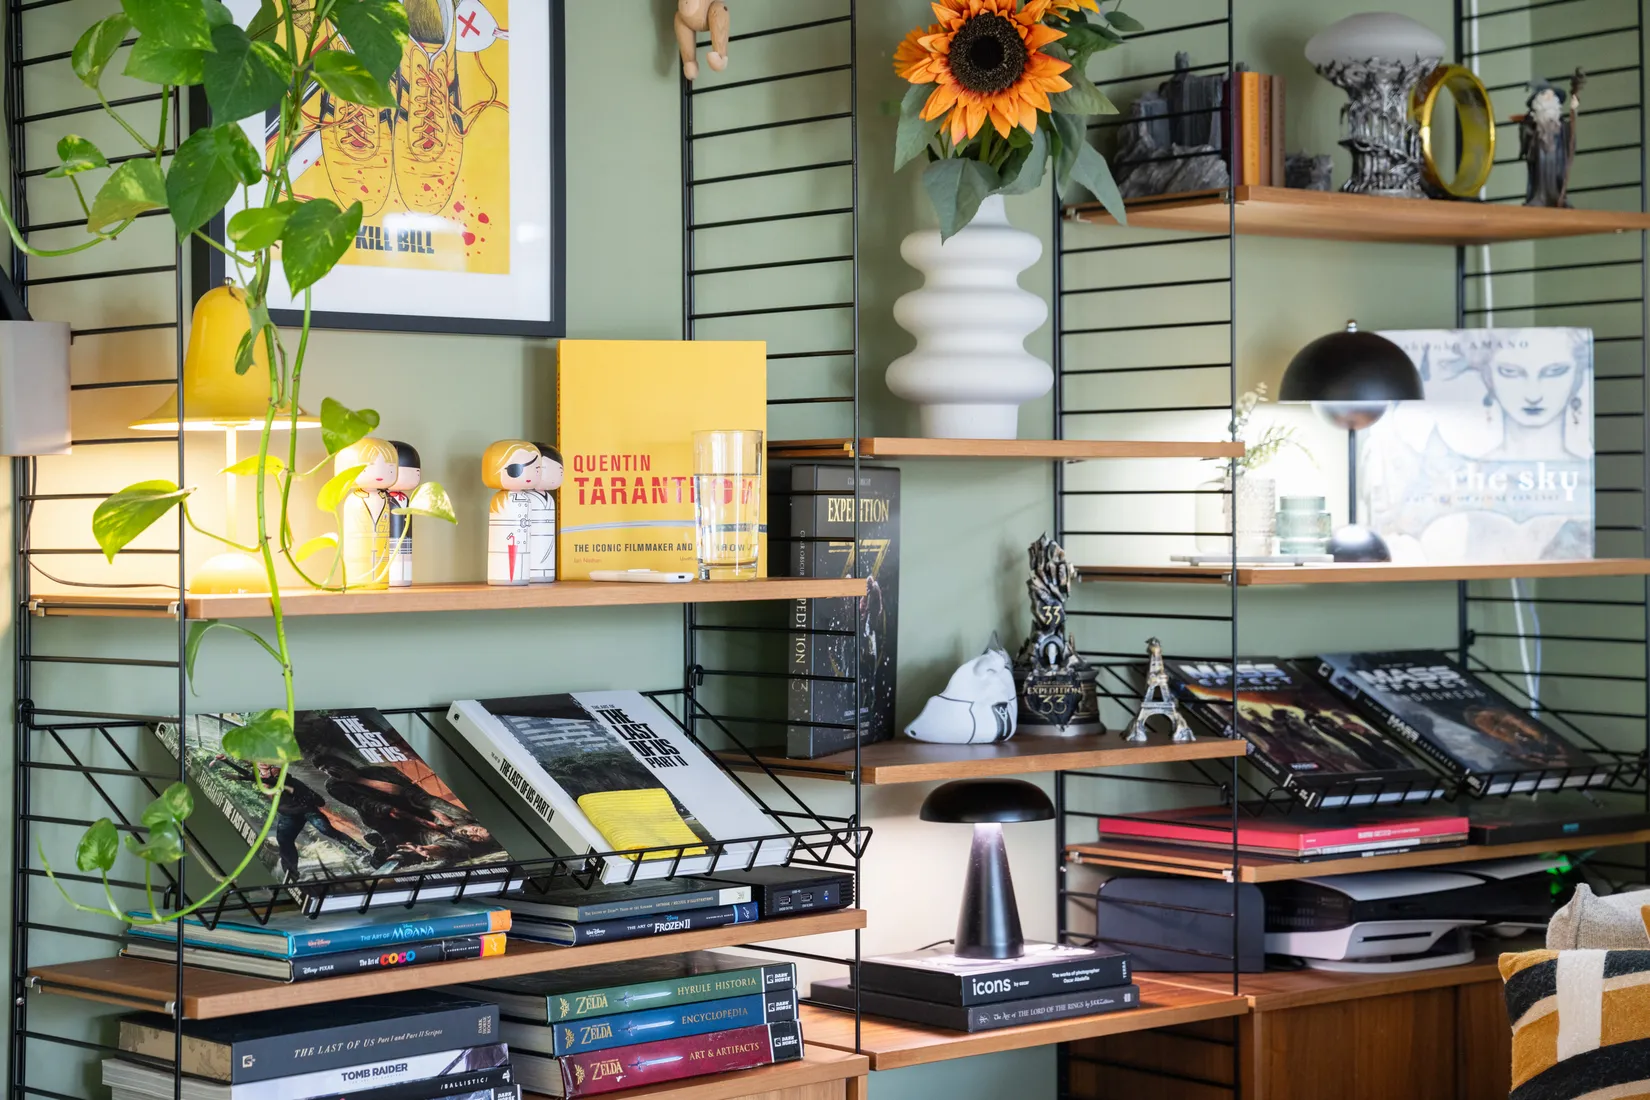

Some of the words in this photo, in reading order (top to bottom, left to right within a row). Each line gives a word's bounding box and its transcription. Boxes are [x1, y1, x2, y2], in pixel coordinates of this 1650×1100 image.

[355, 225, 392, 251] KILL
[397, 228, 434, 254] BILL
[1469, 340, 1529, 350] AMANO
[573, 455, 651, 473] QUENTIN
[1518, 461, 1578, 501] sky
[827, 498, 890, 522] EXPEITION
[574, 544, 589, 552] THE
[592, 544, 620, 552] ICONIC
[625, 543, 674, 551] FILMMAKER
[677, 542, 693, 551] AND
[1042, 606, 1062, 625] 33
[1356, 665, 1461, 684] MASS
[1027, 687, 1082, 695] EXPEDITION
[1374, 679, 1468, 692] EFFECT
[1038, 695, 1067, 714] 33
[596, 708, 636, 724] THE
[332, 718, 370, 734] THE
[611, 723, 660, 740] LAST
[344, 732, 390, 748] LAST
[628, 740, 656, 756] OF
[648, 738, 681, 755] US
[358, 747, 385, 763] OF
[377, 746, 408, 762] US
[644, 756, 679, 768] PART
[674, 755, 689, 766] II
[499, 758, 512, 778] THE
[507, 767, 523, 790] LAST
[519, 779, 530, 796] OF
[525, 786, 536, 803] US
[532, 793, 550, 817] PART
[546, 808, 555, 823] II
[222, 798, 234, 819] THE
[230, 808, 245, 832] LAST
[240, 821, 251, 839] OF
[246, 828, 257, 847] US
[391, 925, 434, 940] MOANA
[654, 920, 684, 934] FROZEN
[684, 918, 691, 929] II
[380, 949, 416, 965] COCO
[319, 964, 334, 972] PIXAR
[1075, 968, 1100, 976] photographer
[677, 983, 711, 996] HYRULE
[715, 977, 757, 991] HISTORIA
[972, 977, 1011, 996] icons
[576, 995, 609, 1014] ZELDA
[1018, 1009, 1029, 1017] THE
[1030, 1007, 1046, 1016] LORD
[1046, 1005, 1054, 1013] OF
[1055, 1003, 1067, 1012] THE
[1067, 1001, 1084, 1010] RINGS
[681, 1007, 748, 1025] ENCYCLOPEDIA
[580, 1025, 613, 1044] ZELDA
[294, 1046, 314, 1059] THE
[317, 1042, 344, 1055] LAST
[346, 1039, 361, 1050] OF
[363, 1037, 376, 1048] US
[377, 1036, 390, 1044] Part
[394, 1033, 405, 1041] and
[424, 1029, 443, 1037] Scripts
[689, 1050, 705, 1061] ART
[707, 1049, 714, 1057] &
[716, 1042, 760, 1056] ARTIFACTS
[341, 1068, 371, 1081] TOMB
[372, 1062, 408, 1076] RAIDER
[590, 1061, 623, 1081] ZELDA
